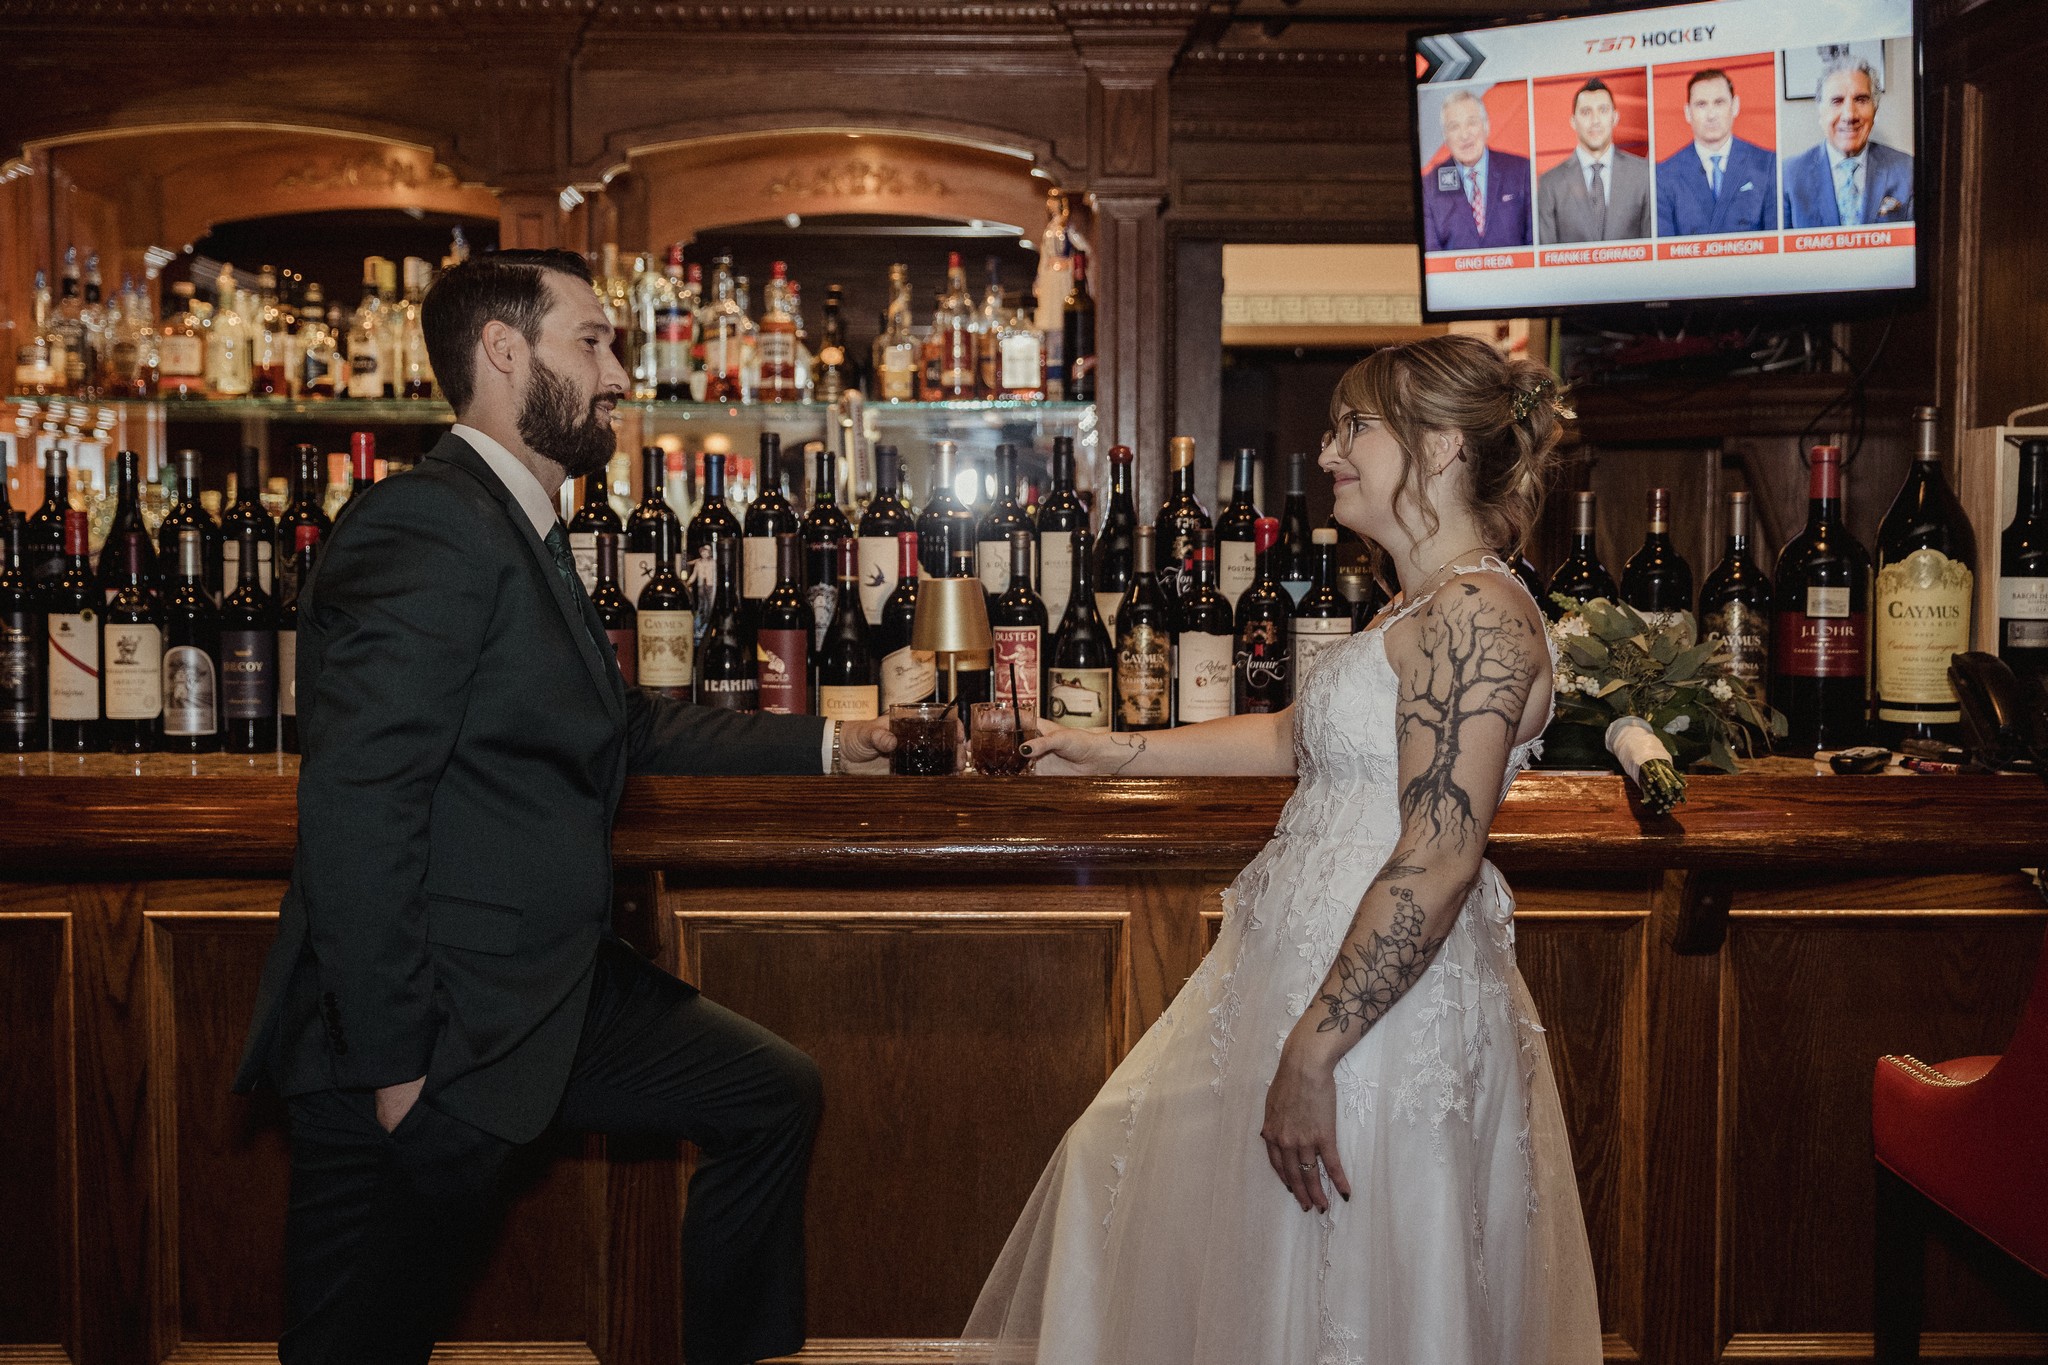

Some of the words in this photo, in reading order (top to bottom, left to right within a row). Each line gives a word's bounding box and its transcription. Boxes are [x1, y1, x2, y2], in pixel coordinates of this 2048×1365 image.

[1584, 35, 1636, 54] TSN
[1642, 25, 1715, 47] HOCKEY
[1670, 242, 1700, 258] MIKE
[1703, 239, 1764, 255] JOHNSON
[1796, 234, 1833, 250] CRAIG
[1836, 231, 1891, 248] BUTTON
[1455, 257, 1482, 271] GINO
[1484, 254, 1513, 269] REDA
[1545, 250, 1590, 265] FRANKIE
[1592, 246, 1646, 263] CORRADO
[1888, 600, 1960, 619] CAYMUS
[643, 618, 684, 629] CAYMUS
[1801, 625, 1809, 637] J.
[1812, 626, 1855, 637] LOHR
[995, 631, 1036, 642] DUSTED
[1121, 650, 1165, 664] CAYMUS
[826, 698, 870, 708] CITATION
